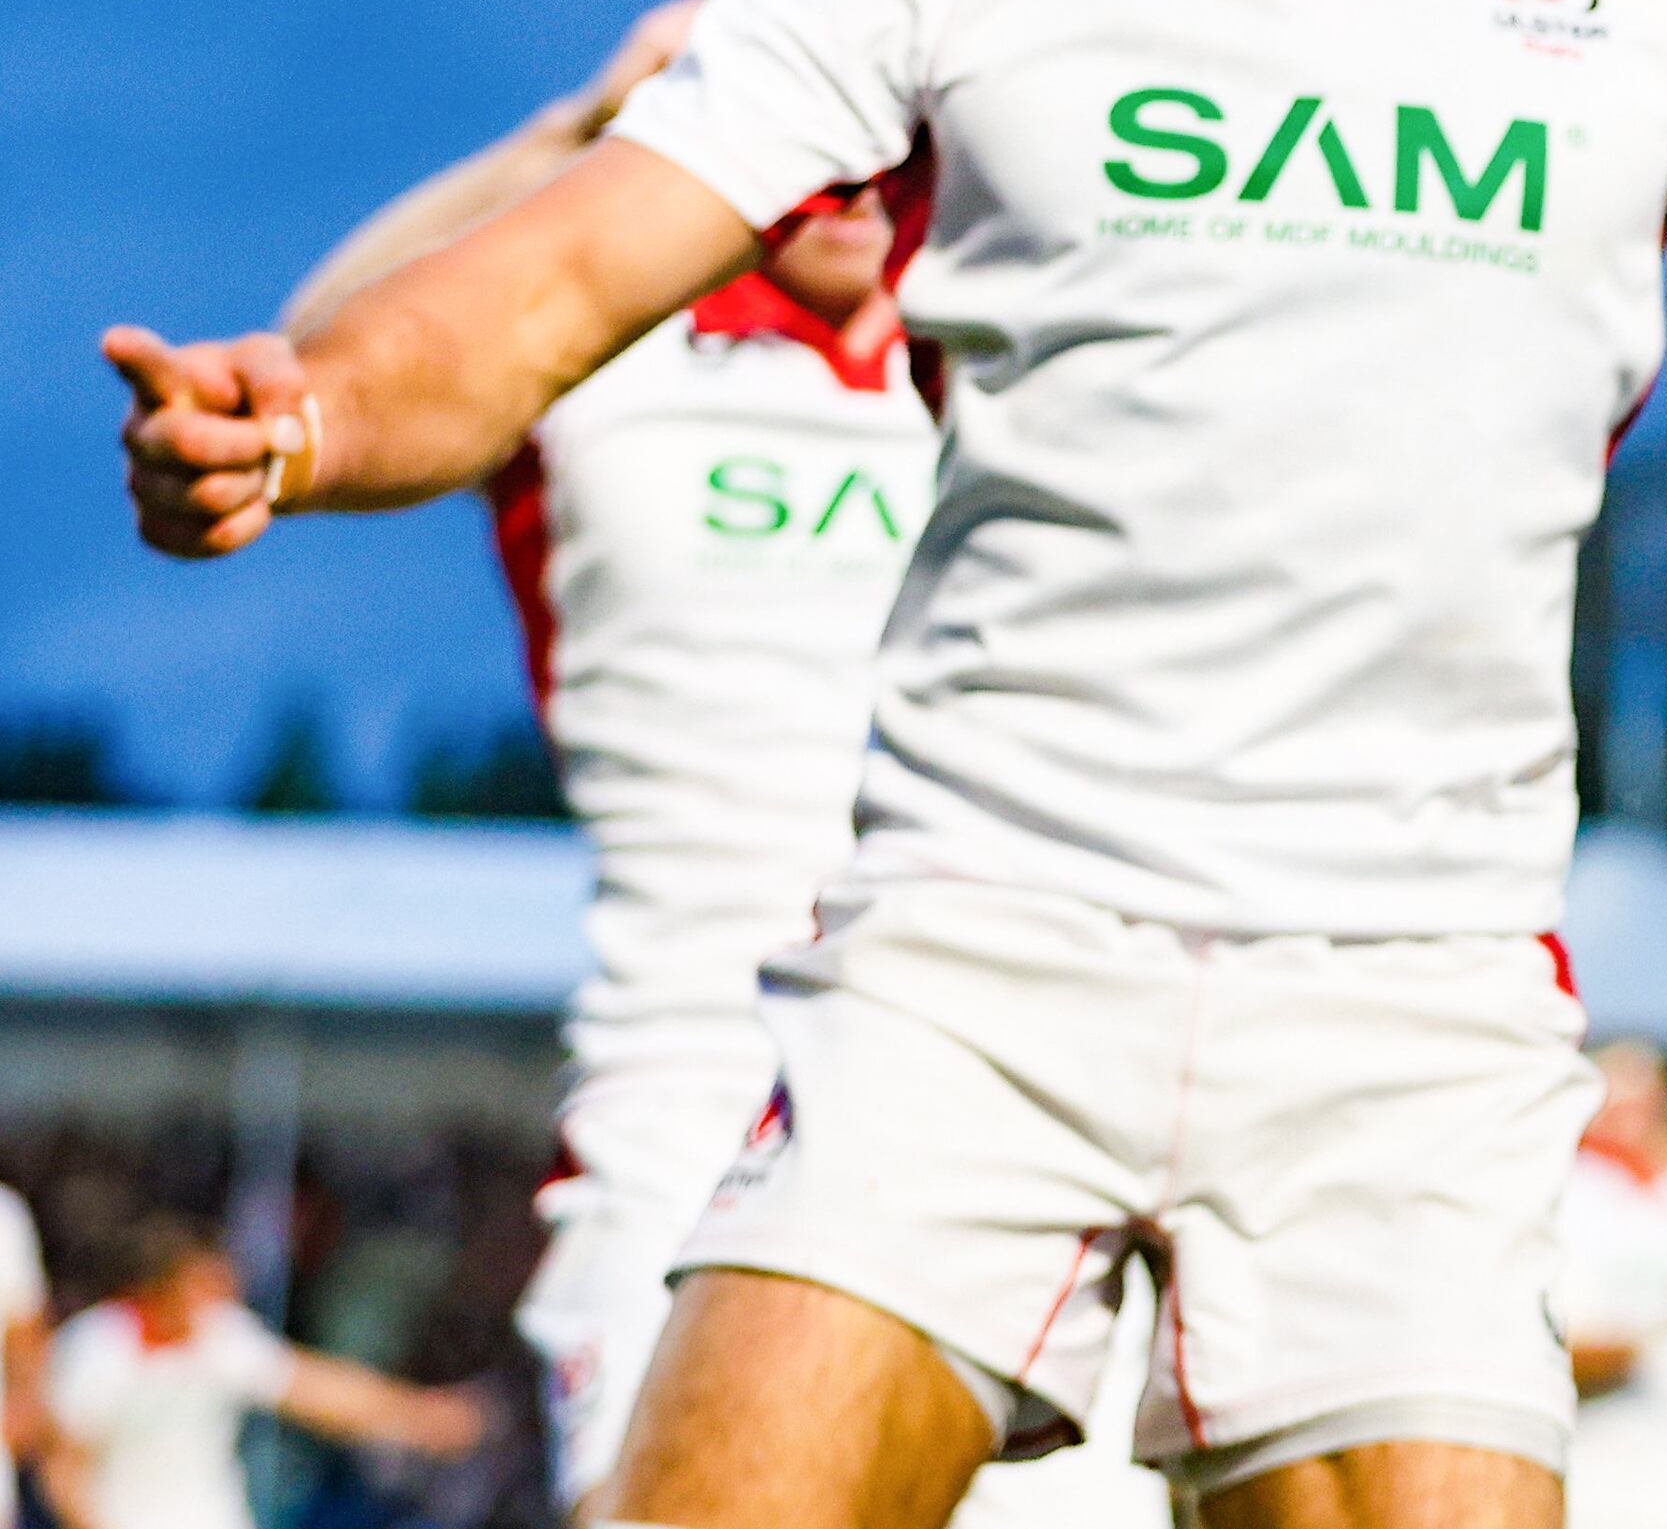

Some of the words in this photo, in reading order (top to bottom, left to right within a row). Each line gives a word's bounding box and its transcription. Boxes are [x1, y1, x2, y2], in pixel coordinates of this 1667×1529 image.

[1103, 87, 1547, 232] SAM
[1099, 212, 1192, 244] HOME
[1208, 217, 1248, 242] OF
[1265, 221, 1332, 247] MDF
[1349, 229, 1541, 274] MOULDINGS
[705, 454, 903, 542] SA
